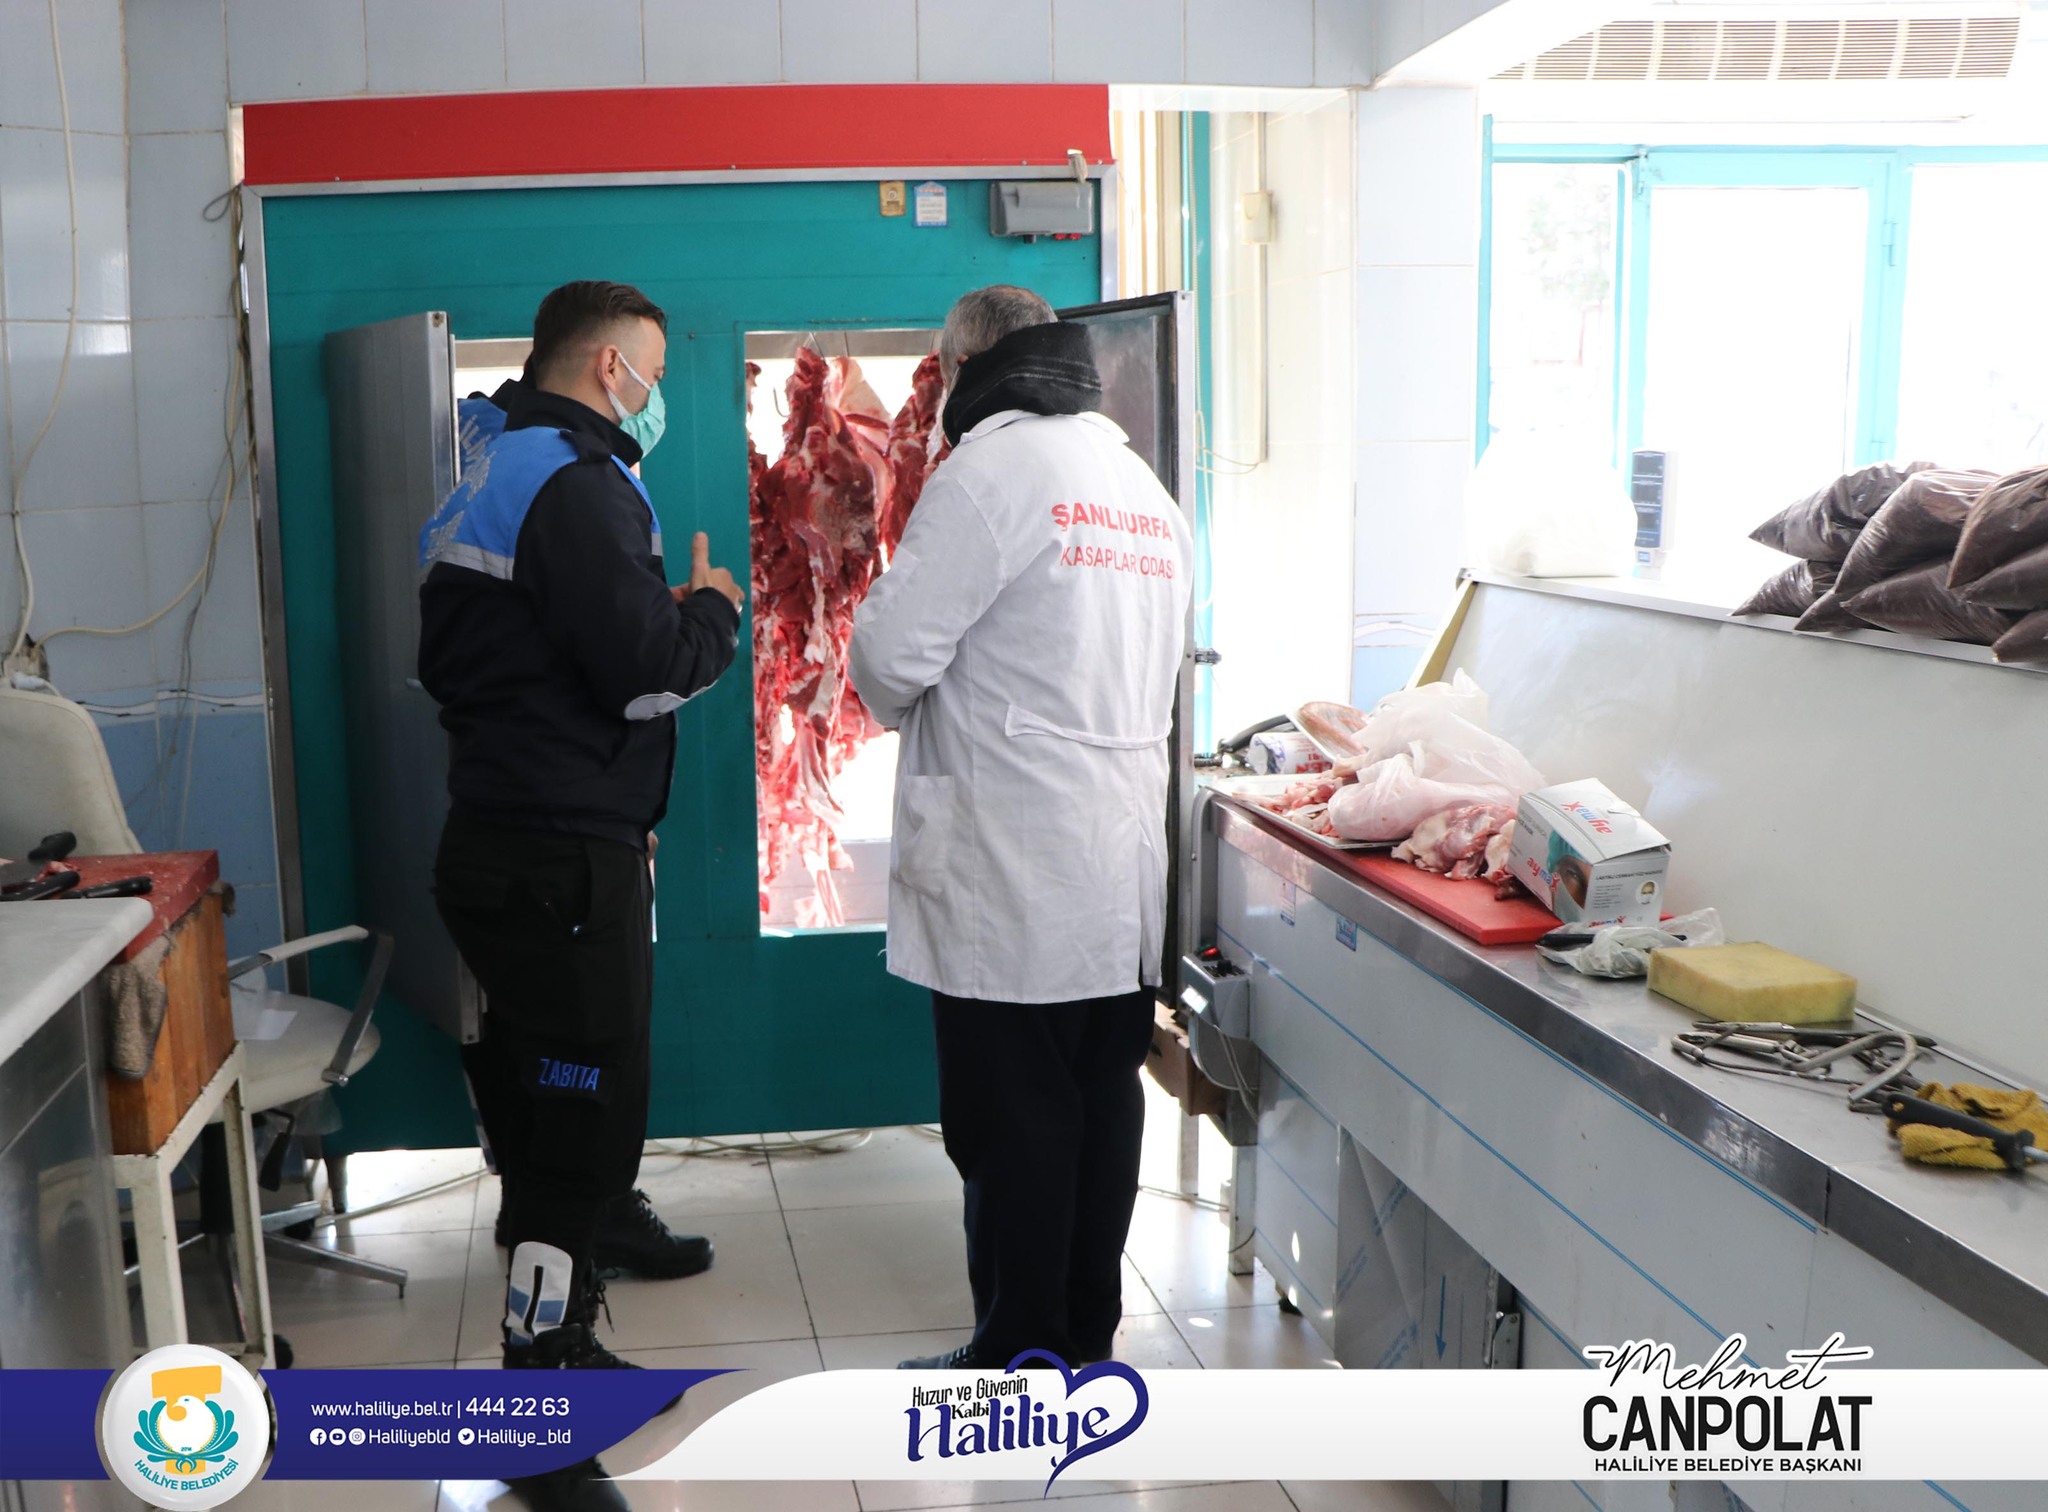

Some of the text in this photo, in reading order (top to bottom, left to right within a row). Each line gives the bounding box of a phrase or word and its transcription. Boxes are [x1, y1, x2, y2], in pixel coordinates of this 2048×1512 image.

[1051, 503, 1173, 542] ŞANLIURFA
[1060, 545, 1138, 574] KASAPLAR
[539, 1058, 600, 1091] ZABITA
